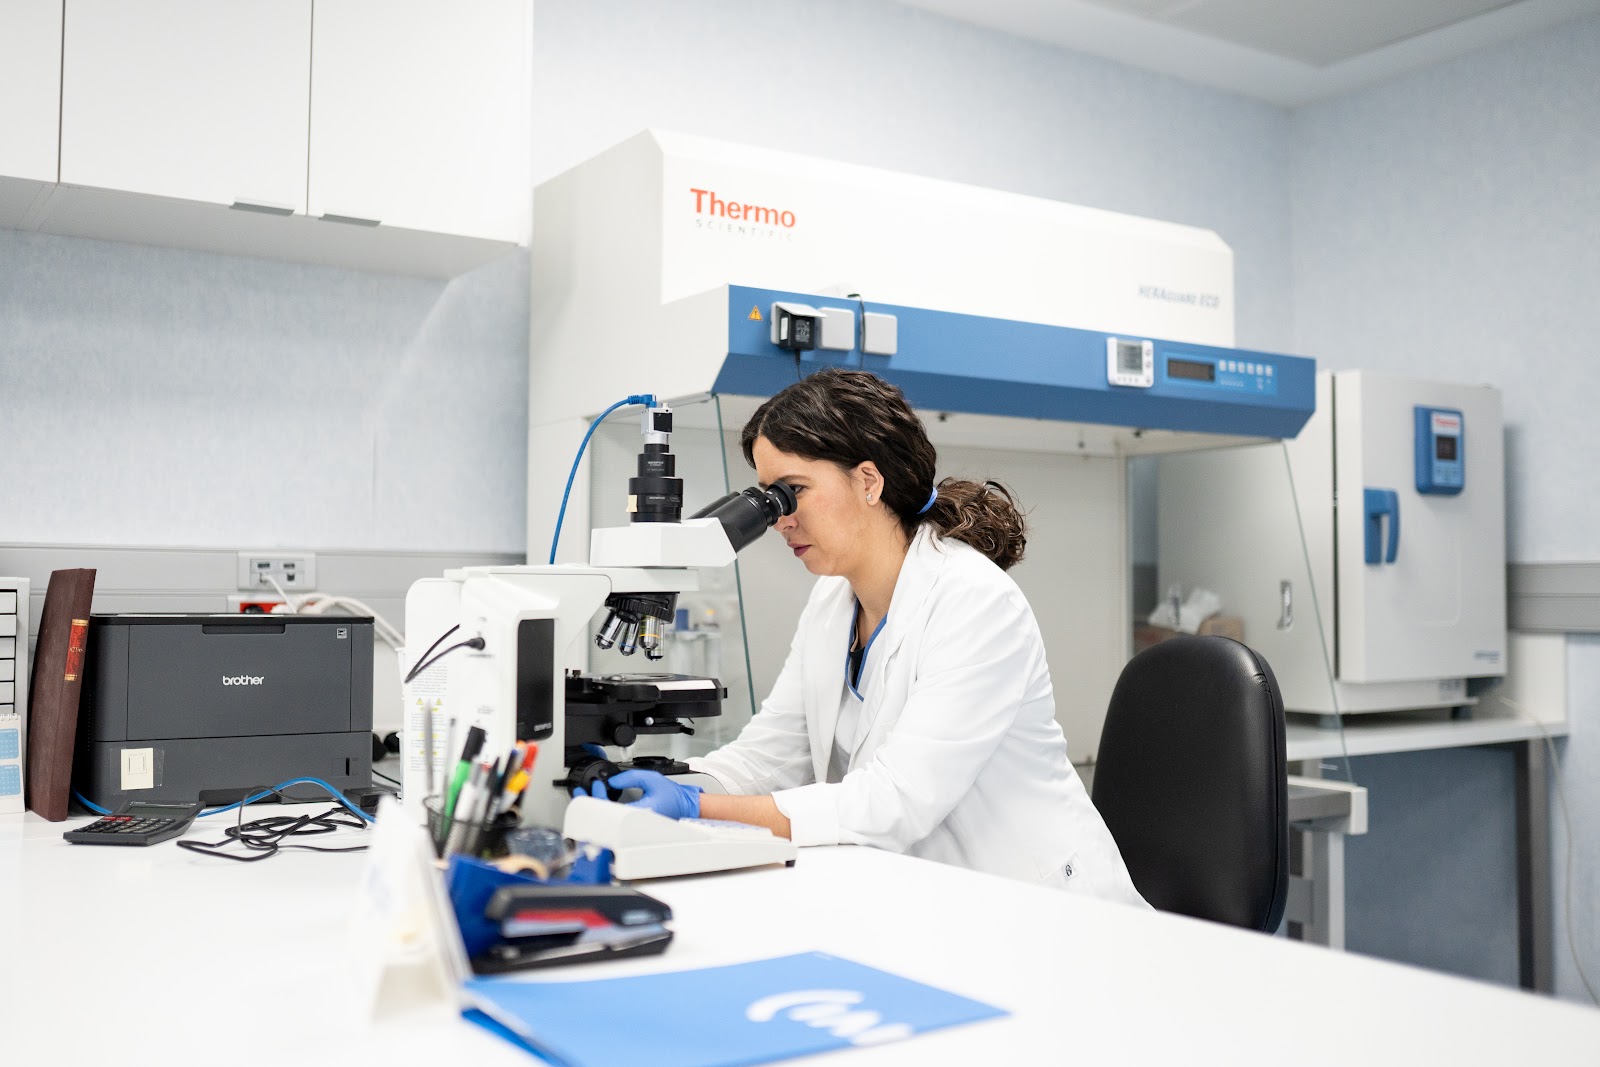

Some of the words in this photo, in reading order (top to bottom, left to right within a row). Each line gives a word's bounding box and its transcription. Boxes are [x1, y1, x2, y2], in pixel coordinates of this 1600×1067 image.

[690, 188, 796, 228] Thermo
[696, 218, 793, 242] SCIENTIFIC
[222, 675, 265, 686] brother
